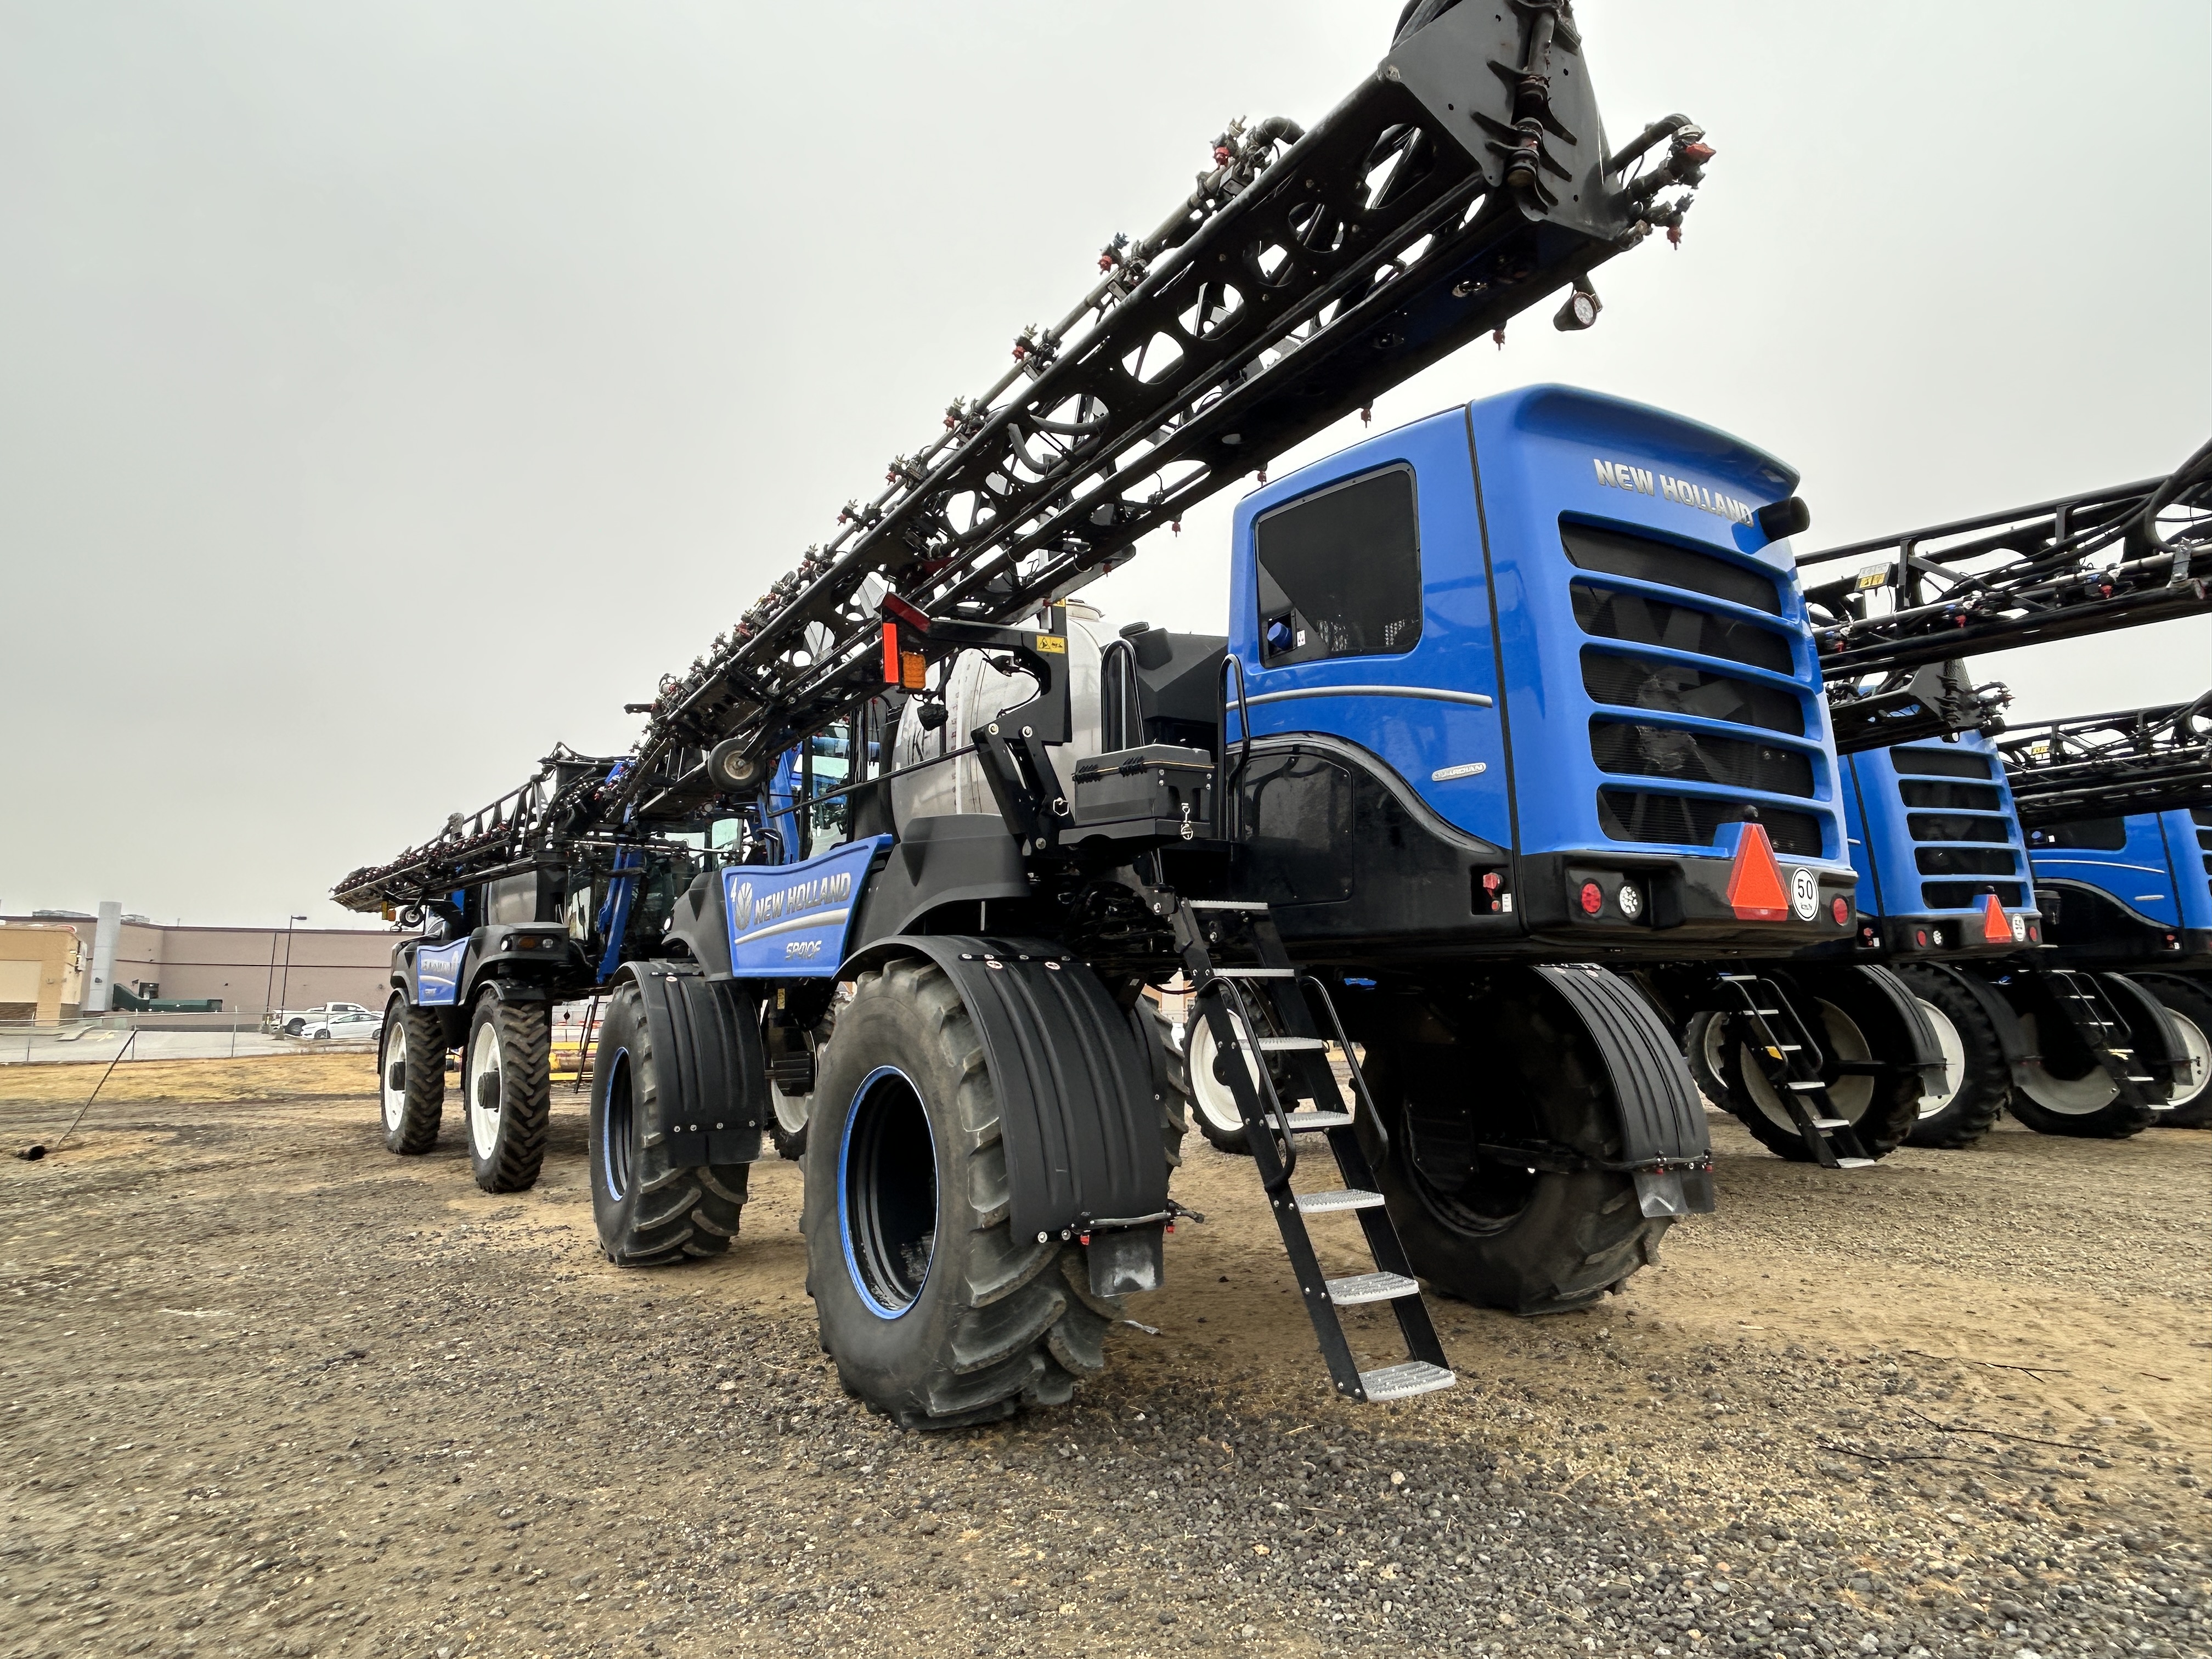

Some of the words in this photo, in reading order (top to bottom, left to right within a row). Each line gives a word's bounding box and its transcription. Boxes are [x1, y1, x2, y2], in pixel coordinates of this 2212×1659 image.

[1593, 459, 1655, 496] NEW
[1659, 474, 1754, 528] HOLLAND
[754, 890, 785, 925] NEW
[786, 872, 851, 915] HOLLAND
[1798, 879, 1813, 900] 50
